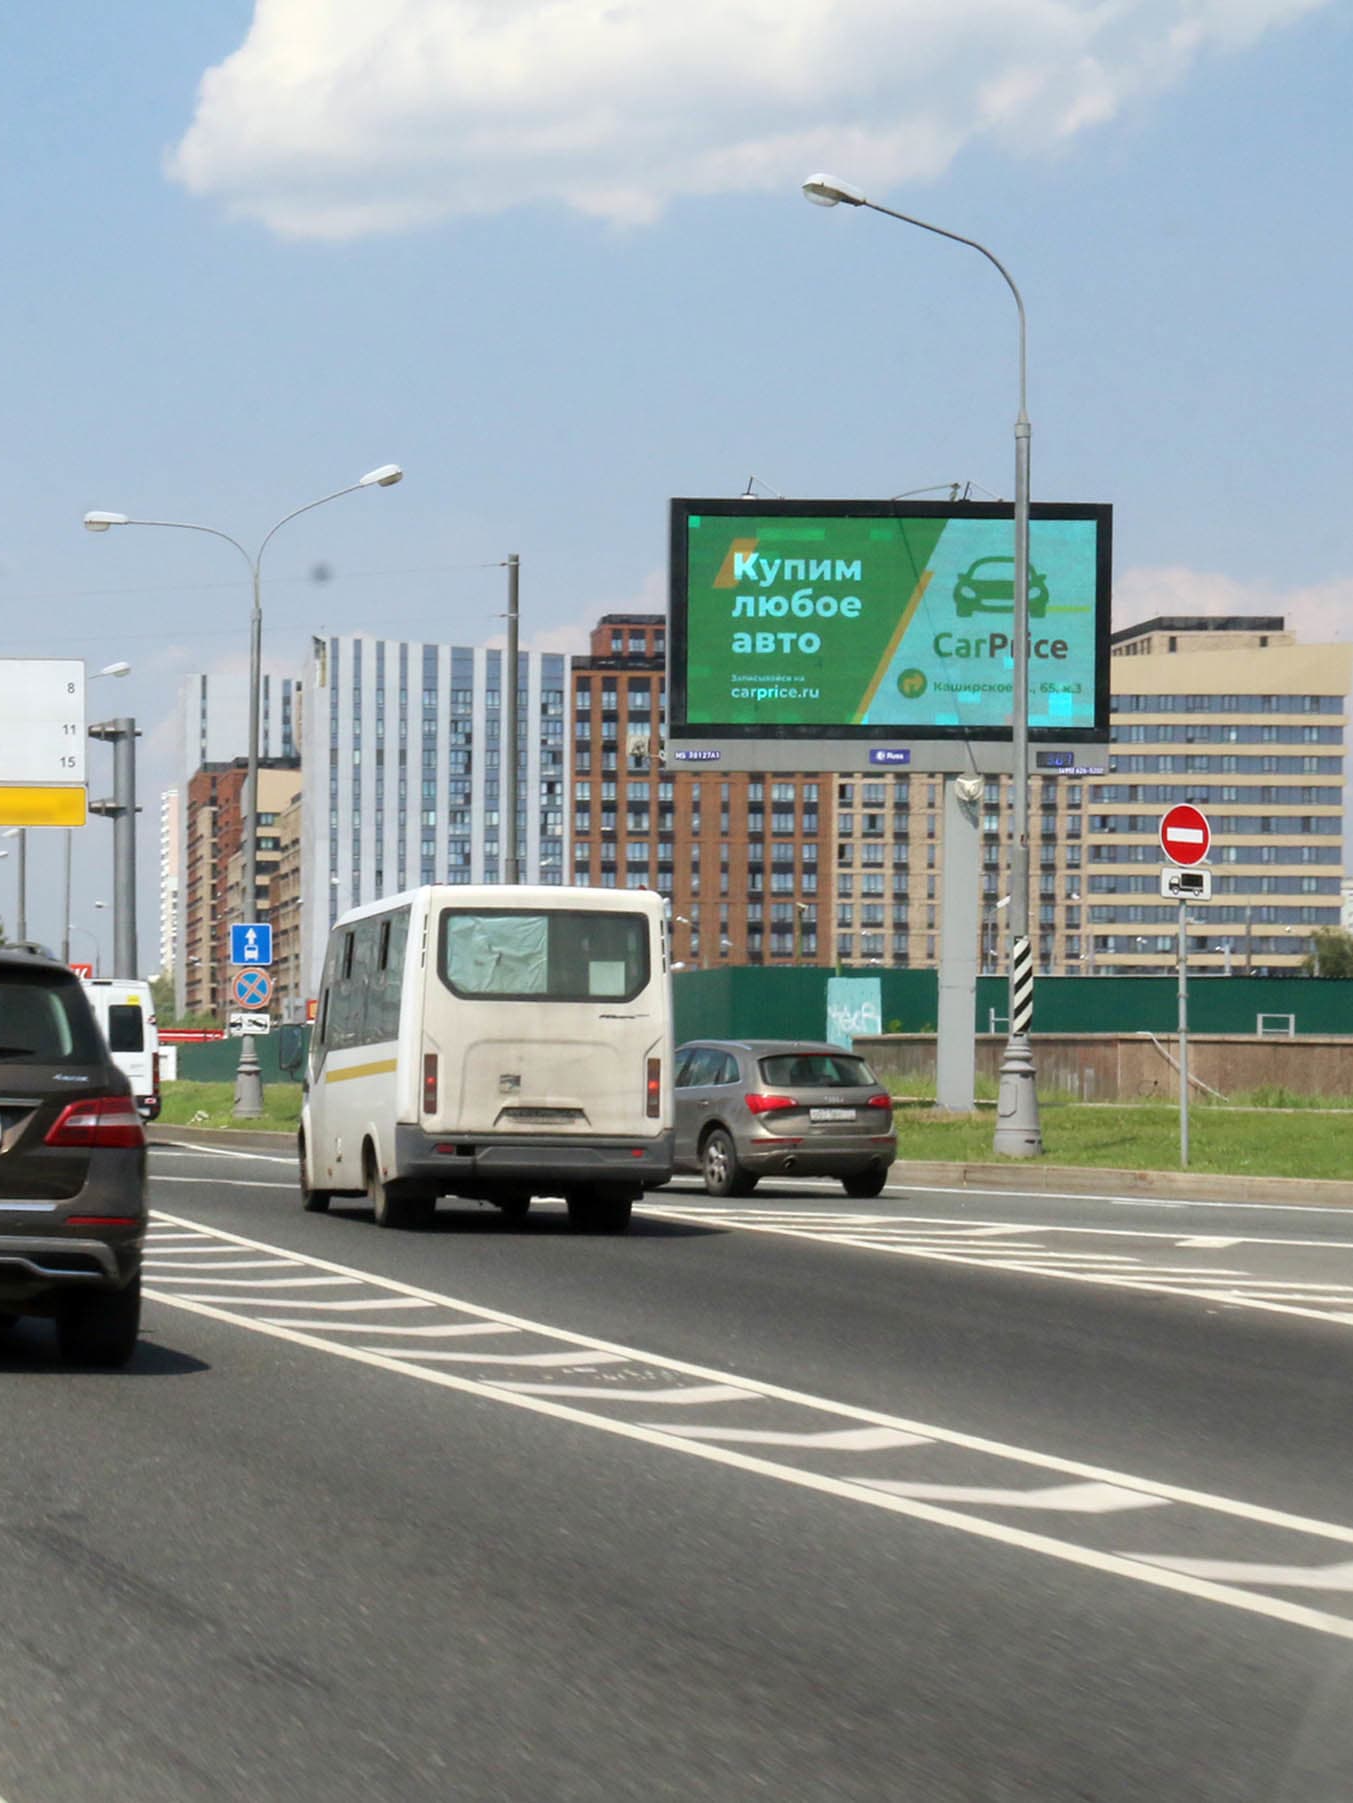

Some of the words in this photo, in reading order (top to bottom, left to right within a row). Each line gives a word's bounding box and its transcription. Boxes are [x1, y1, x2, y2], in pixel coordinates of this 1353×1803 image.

[733, 551, 862, 588] Купим
[731, 587, 862, 618] любое
[731, 631, 822, 655] авто
[932, 631, 1068, 660] CarPice
[67, 681, 76, 694] 8
[731, 684, 820, 701] carprice.ru
[933, 681, 1014, 694] Каширское
[62, 724, 76, 735] 11
[59, 756, 76, 768] 15
